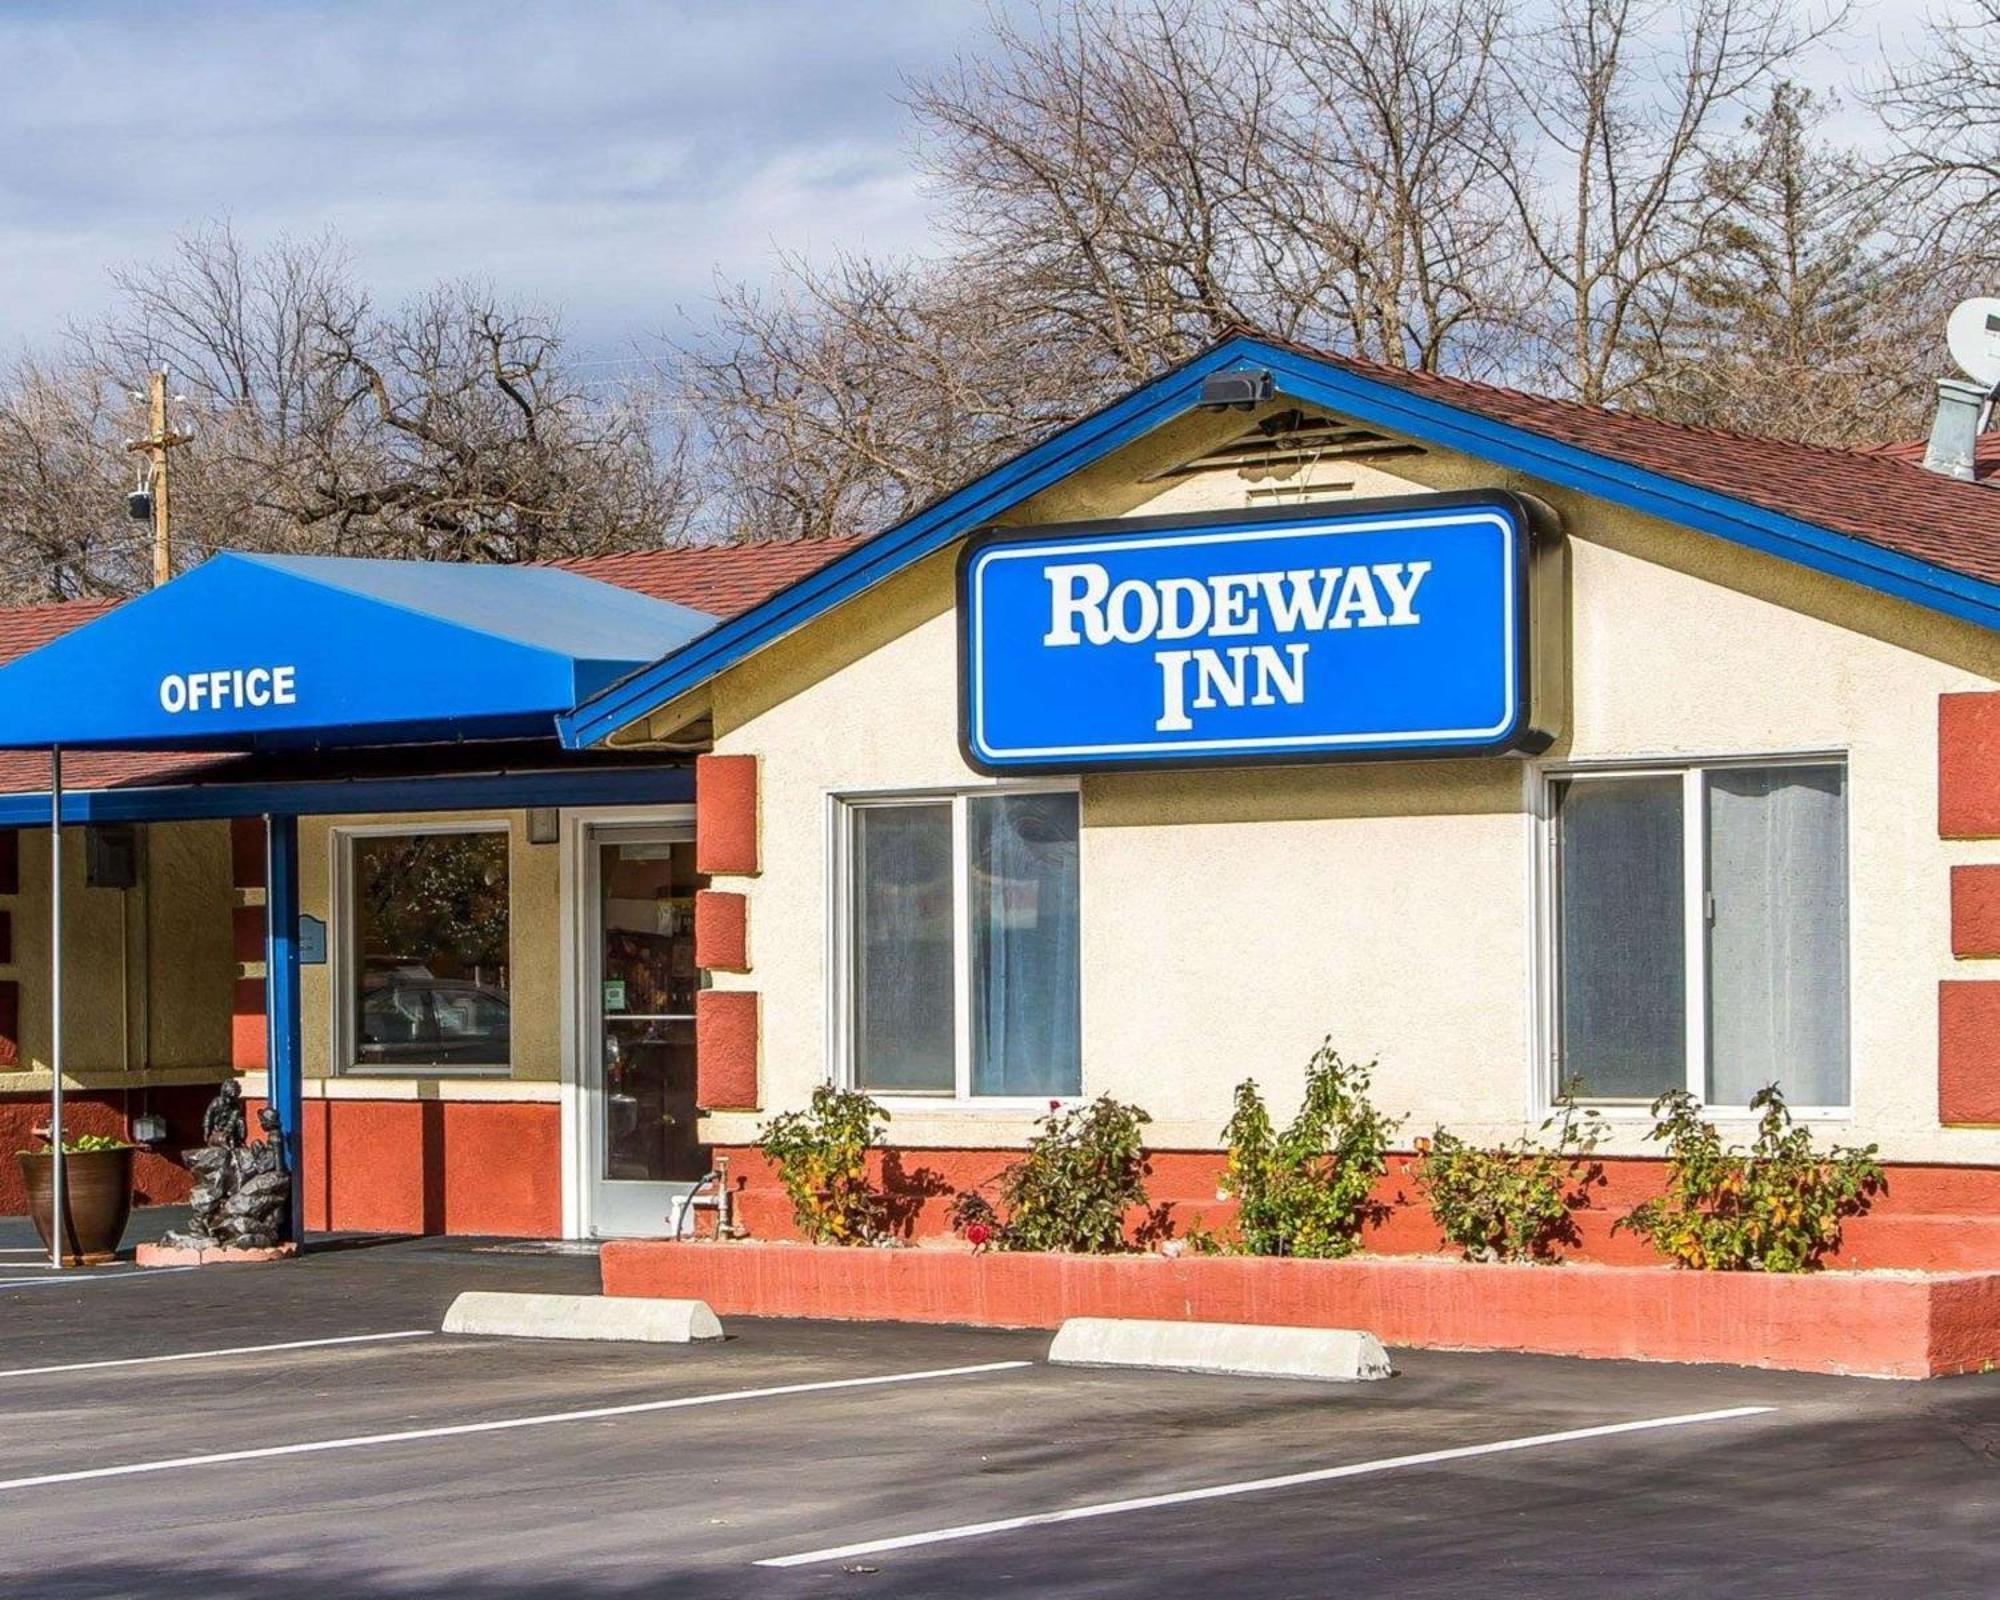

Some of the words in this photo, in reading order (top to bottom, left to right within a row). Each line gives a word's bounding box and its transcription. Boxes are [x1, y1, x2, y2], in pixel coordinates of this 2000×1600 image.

[1043, 561, 1432, 647] RODEWAY
[160, 666, 296, 713] OFFICE
[1155, 643, 1310, 732] INN
